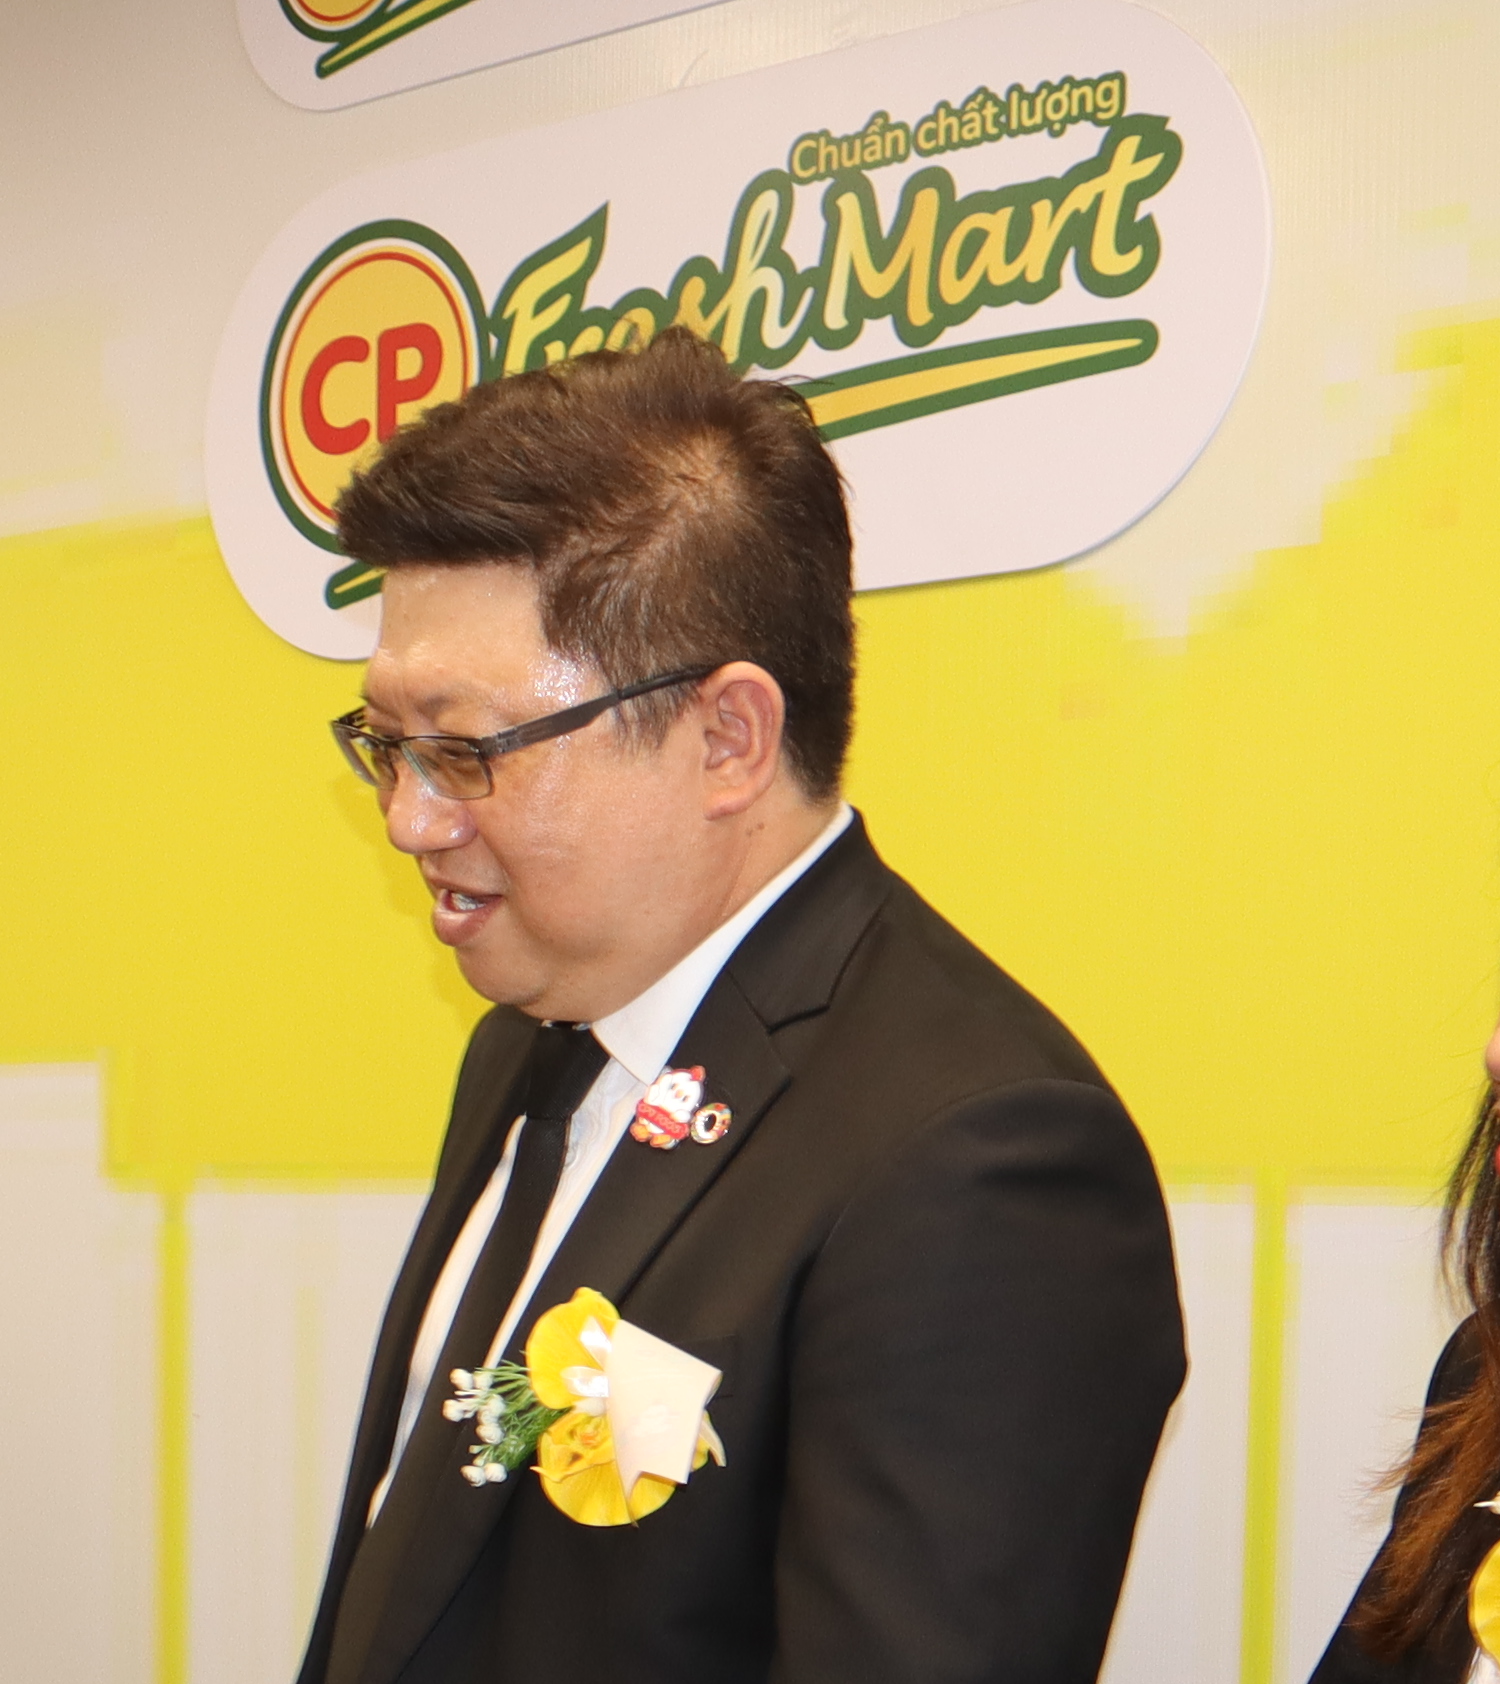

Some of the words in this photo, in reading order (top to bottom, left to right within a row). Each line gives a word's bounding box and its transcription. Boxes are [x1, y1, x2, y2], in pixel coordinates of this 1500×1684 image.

[792, 117, 907, 178] Chuẩn
[916, 89, 1000, 151] chất
[1009, 79, 1120, 139] lượng
[823, 135, 1165, 329] Mart
[302, 322, 443, 455] CP
